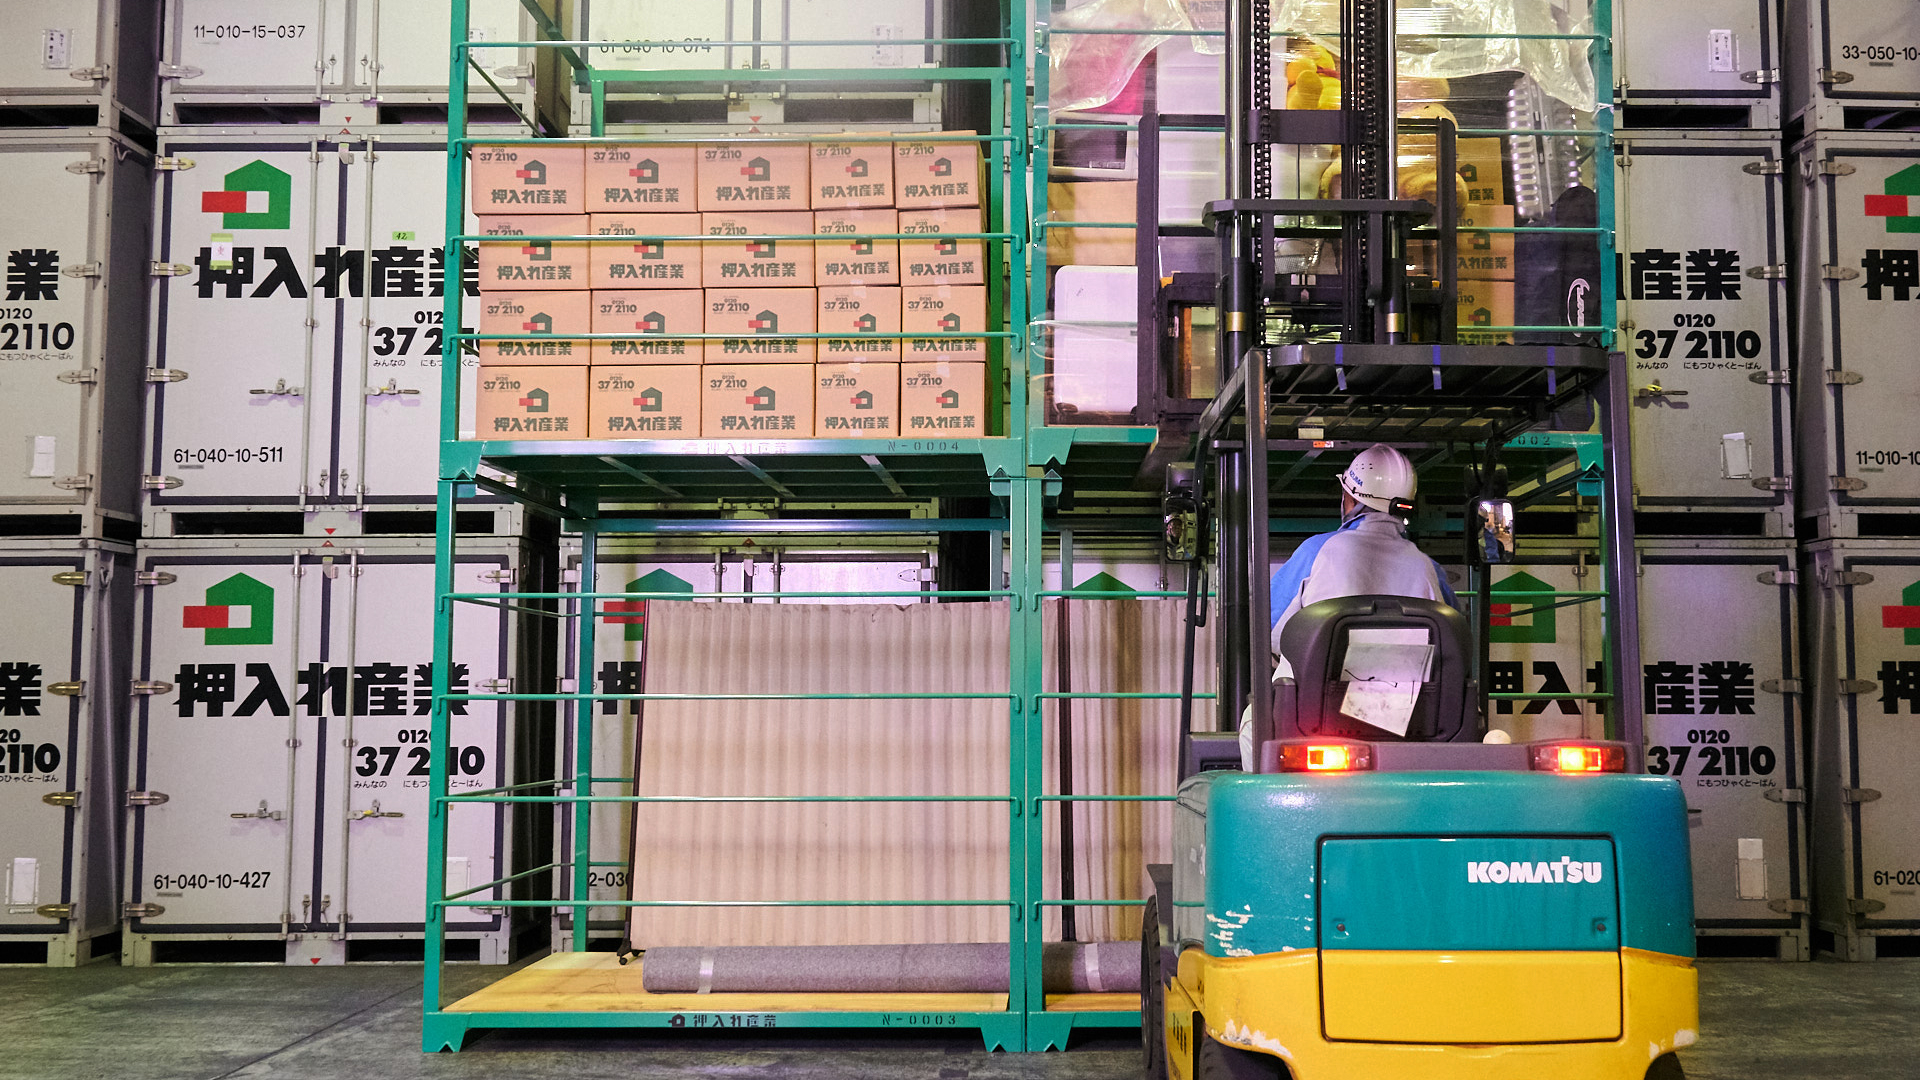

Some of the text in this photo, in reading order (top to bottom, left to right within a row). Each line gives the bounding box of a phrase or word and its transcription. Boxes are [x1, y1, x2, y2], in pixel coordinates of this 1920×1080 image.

[193, 24, 305, 39] 11-010-15-037
[480, 153, 518, 162] 37 2110
[594, 152, 630, 160] 37 2110
[705, 150, 742, 160] 37 2110
[816, 146, 851, 156] 37 2110
[899, 146, 934, 155] 37 2110
[491, 189, 567, 204] 押入れ産業
[604, 188, 679, 203] 押入れ産業
[716, 186, 791, 200] 押入れ産業
[821, 183, 885, 198] 押入れ産業
[905, 182, 968, 198] 押入れ産業
[710, 226, 747, 235] 37 2110
[820, 224, 856, 233] 37 2110
[904, 225, 939, 233] 37 2110
[6, 249, 59, 300] 業
[497, 265, 572, 280] 押入れ産業
[609, 264, 684, 279] 押入れ産業
[721, 262, 796, 277] 押入れ産業
[825, 262, 890, 276] 押入れ産業
[910, 262, 974, 276] 押入れ産業
[1616, 248, 1742, 301] 産業
[1860, 249, 1920, 301] 押
[487, 305, 524, 314] 37 2110
[600, 304, 637, 313] 37 2110
[712, 302, 749, 311] 37 2110
[824, 301, 860, 310] 37 2110
[908, 300, 944, 309] 37 2110
[414, 311, 443, 324] 012
[1673, 313, 1716, 329] 0120
[0, 322, 75, 350] 2110
[373, 327, 418, 356] 37
[497, 341, 572, 356] 押入れ産業
[610, 340, 685, 355] 押入れ産業
[723, 339, 798, 353] 押入れ産業
[828, 339, 892, 352] 押入れ産業
[912, 339, 976, 352] 押入れ産業
[1634, 330, 1762, 359] 37 2110
[373, 359, 406, 367] みんなの
[1636, 361, 1668, 370] みんなの
[484, 381, 521, 390] 37 2110
[598, 381, 634, 389] 37 2110
[711, 379, 747, 388] 37 2110
[821, 378, 856, 386] 37 2110
[906, 377, 942, 386] 37 2110
[494, 417, 568, 432] 押入れ産業
[608, 417, 682, 431] 押入れ産業
[720, 416, 796, 430] 押入れ産業
[825, 416, 889, 429] 押入れ産業
[910, 416, 975, 428] 押入れ産業
[1509, 436, 1550, 446] 002
[174, 447, 283, 464] 61-040-10-511
[0, 662, 42, 716] 業
[172, 662, 469, 717] 押入れ産業
[397, 730, 431, 743] 012
[1687, 729, 1730, 744] 0120
[0, 743, 61, 773] 110
[355, 746, 485, 777] 37 210
[1647, 745, 1776, 776] 37 2110
[354, 780, 387, 788] みんなの
[1468, 856, 1602, 884] KOMATSU
[154, 871, 271, 889] 61-040-10-427
[882, 1015, 956, 1026] N-0003
